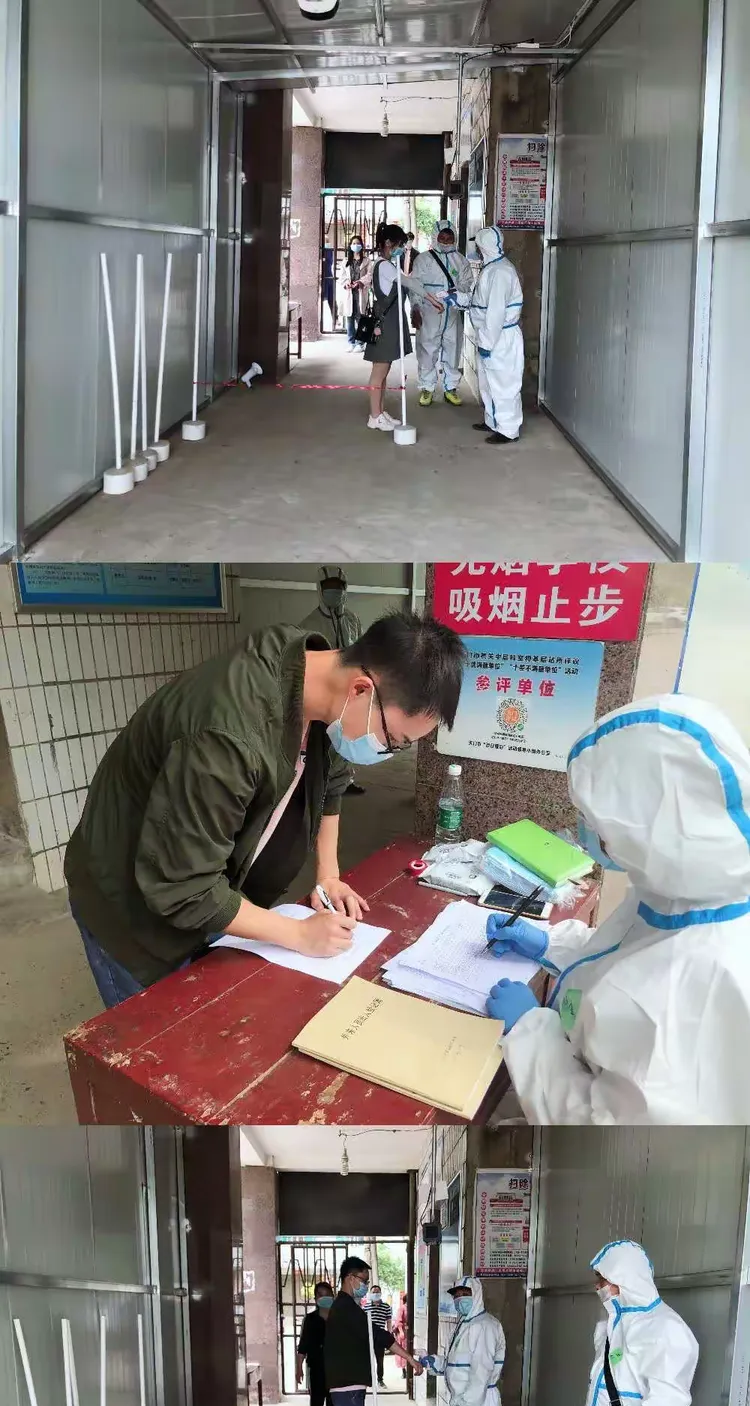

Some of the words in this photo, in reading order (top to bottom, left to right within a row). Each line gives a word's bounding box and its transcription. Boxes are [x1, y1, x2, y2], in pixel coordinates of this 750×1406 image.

[448, 583, 624, 627] 吸烟止步
[475, 674, 556, 697] 参评单位
